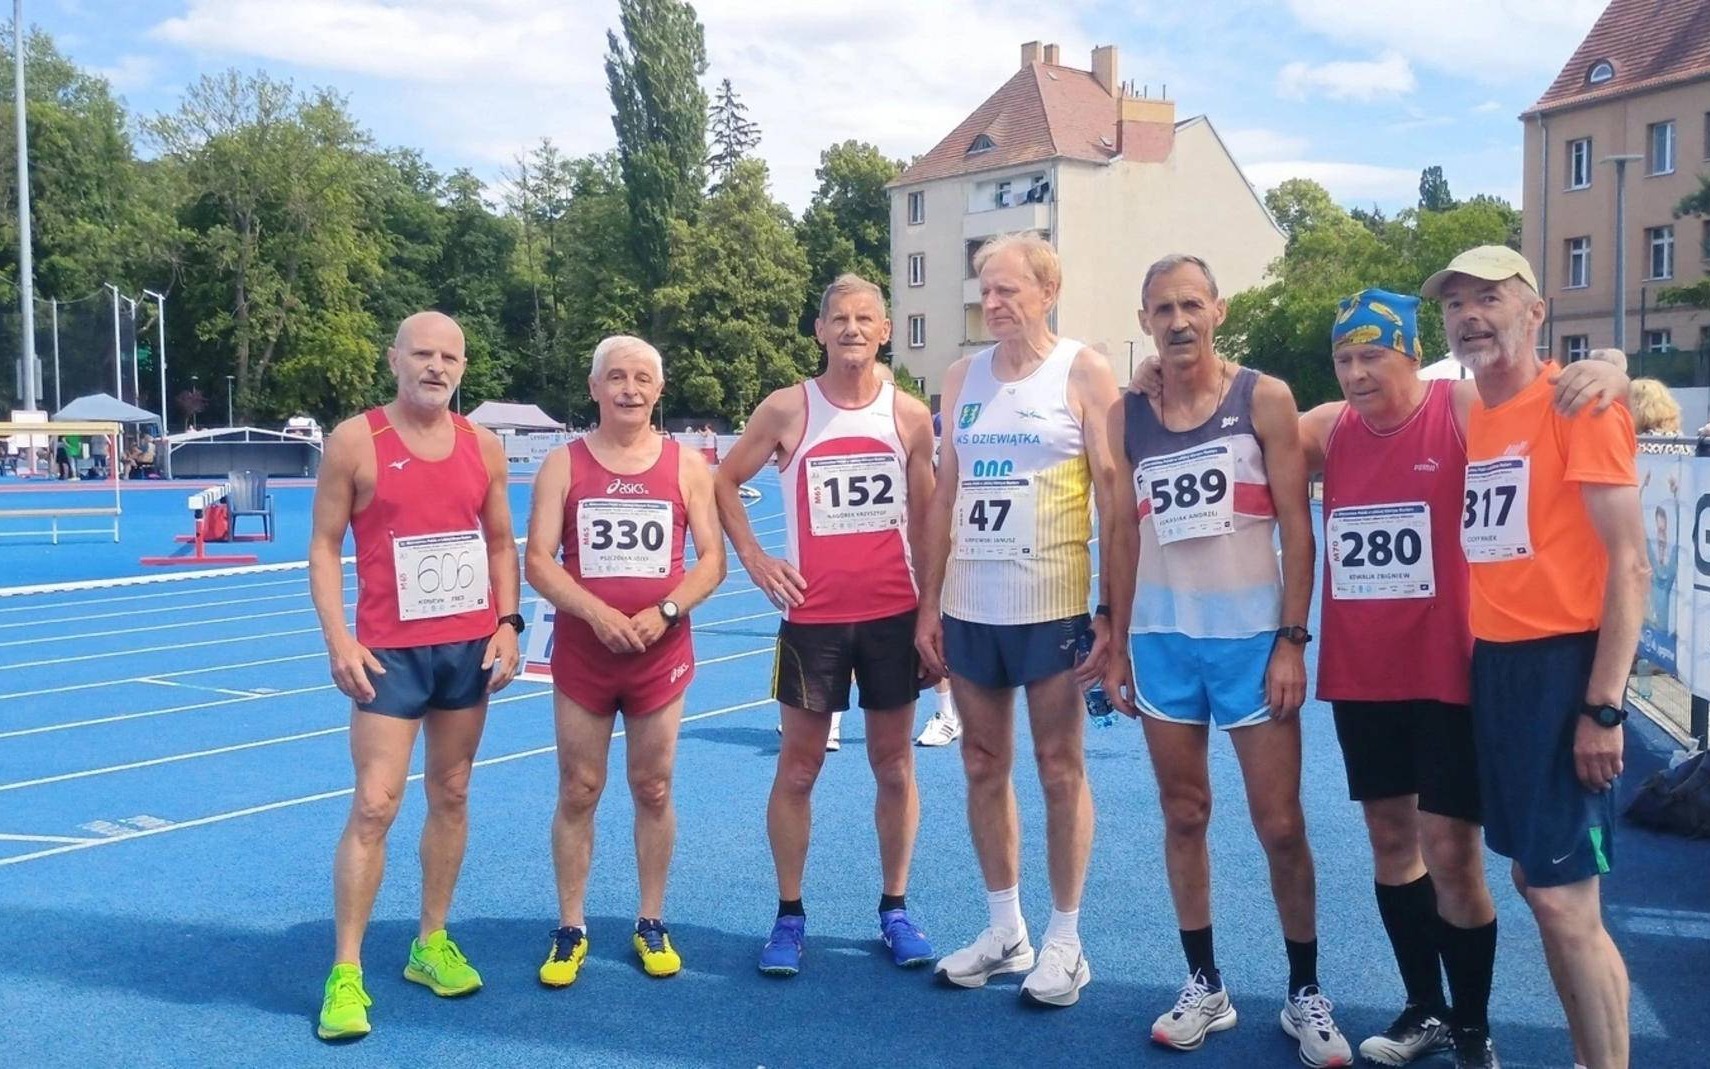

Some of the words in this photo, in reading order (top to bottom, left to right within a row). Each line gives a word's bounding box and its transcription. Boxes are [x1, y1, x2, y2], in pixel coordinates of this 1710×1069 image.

[972, 433, 1041, 446] DZIEWIĄTKA
[823, 473, 894, 508] 152
[1150, 468, 1227, 515] 589
[968, 499, 1012, 532] 47
[590, 519, 664, 552] 330
[1332, 540, 1341, 562] M70
[1340, 528, 1422, 568] 280
[417, 550, 475, 594] 606
